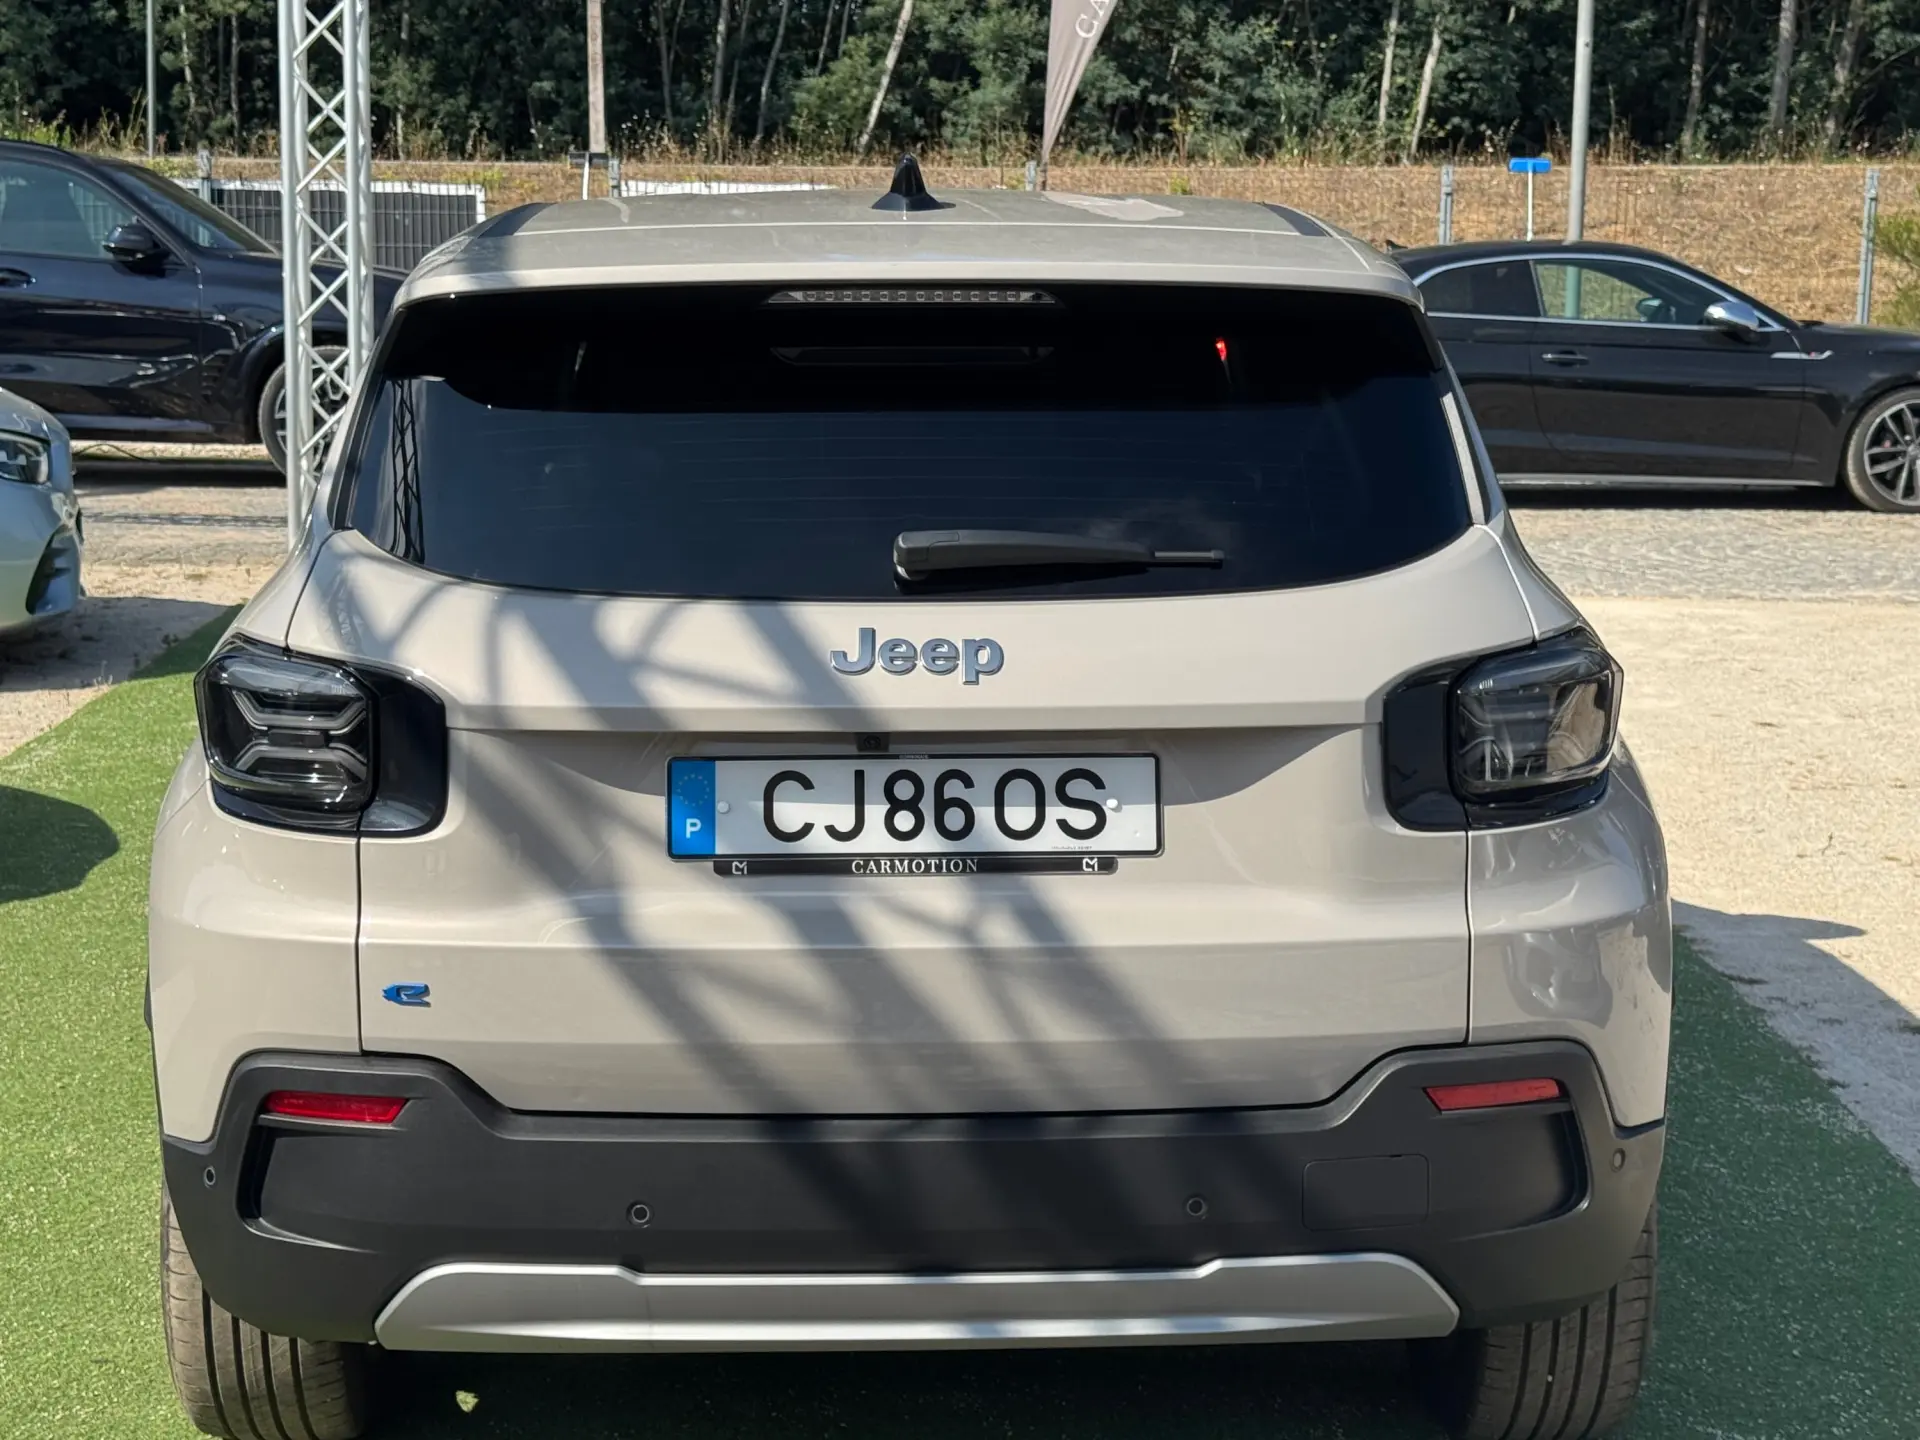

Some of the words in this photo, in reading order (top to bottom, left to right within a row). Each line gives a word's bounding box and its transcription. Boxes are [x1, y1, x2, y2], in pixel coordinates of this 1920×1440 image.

[830, 627, 1004, 686] Jeep
[685, 818, 702, 839] P
[851, 858, 979, 875] CARMOTION
